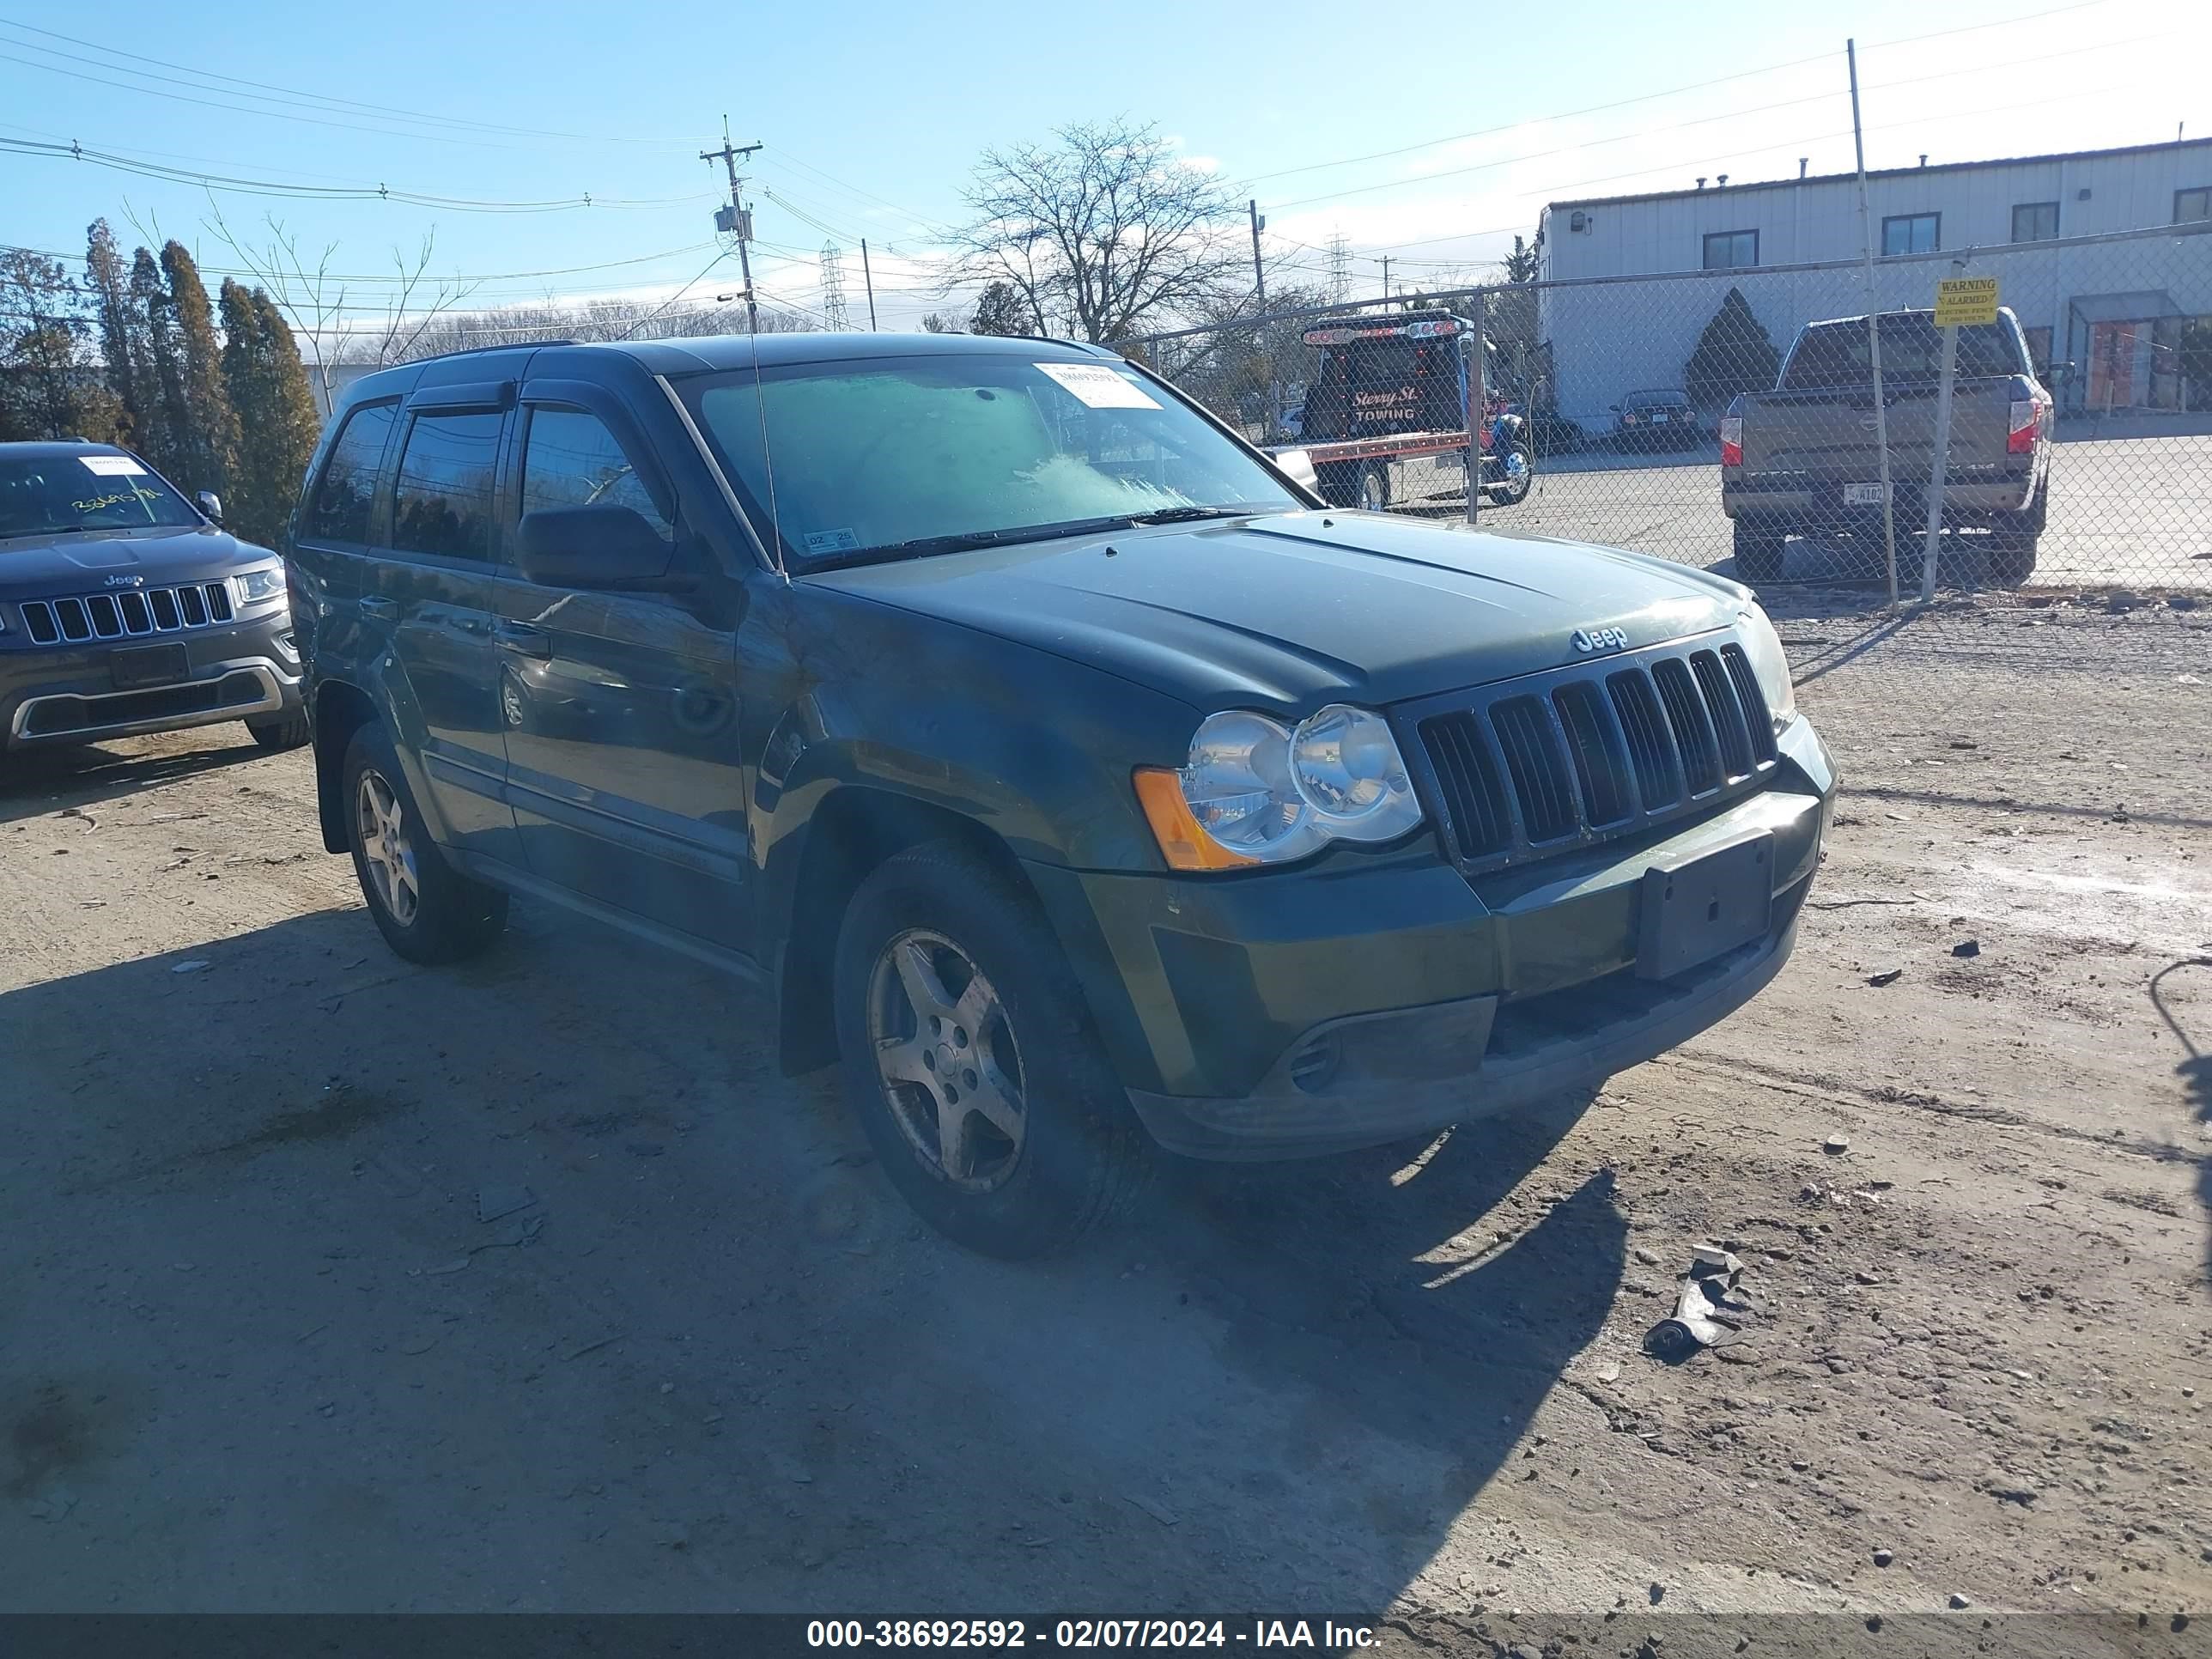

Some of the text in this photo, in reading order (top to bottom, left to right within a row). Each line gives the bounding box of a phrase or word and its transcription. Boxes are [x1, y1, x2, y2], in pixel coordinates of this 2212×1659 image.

[1942, 279, 1996, 291] WARNING
[1948, 295, 1988, 304] ALARMED
[1352, 392, 1397, 407] Sterry
[1355, 408, 1414, 422] TOWING
[104, 574, 144, 587] Jeep
[1573, 626, 1628, 653] Jeep
